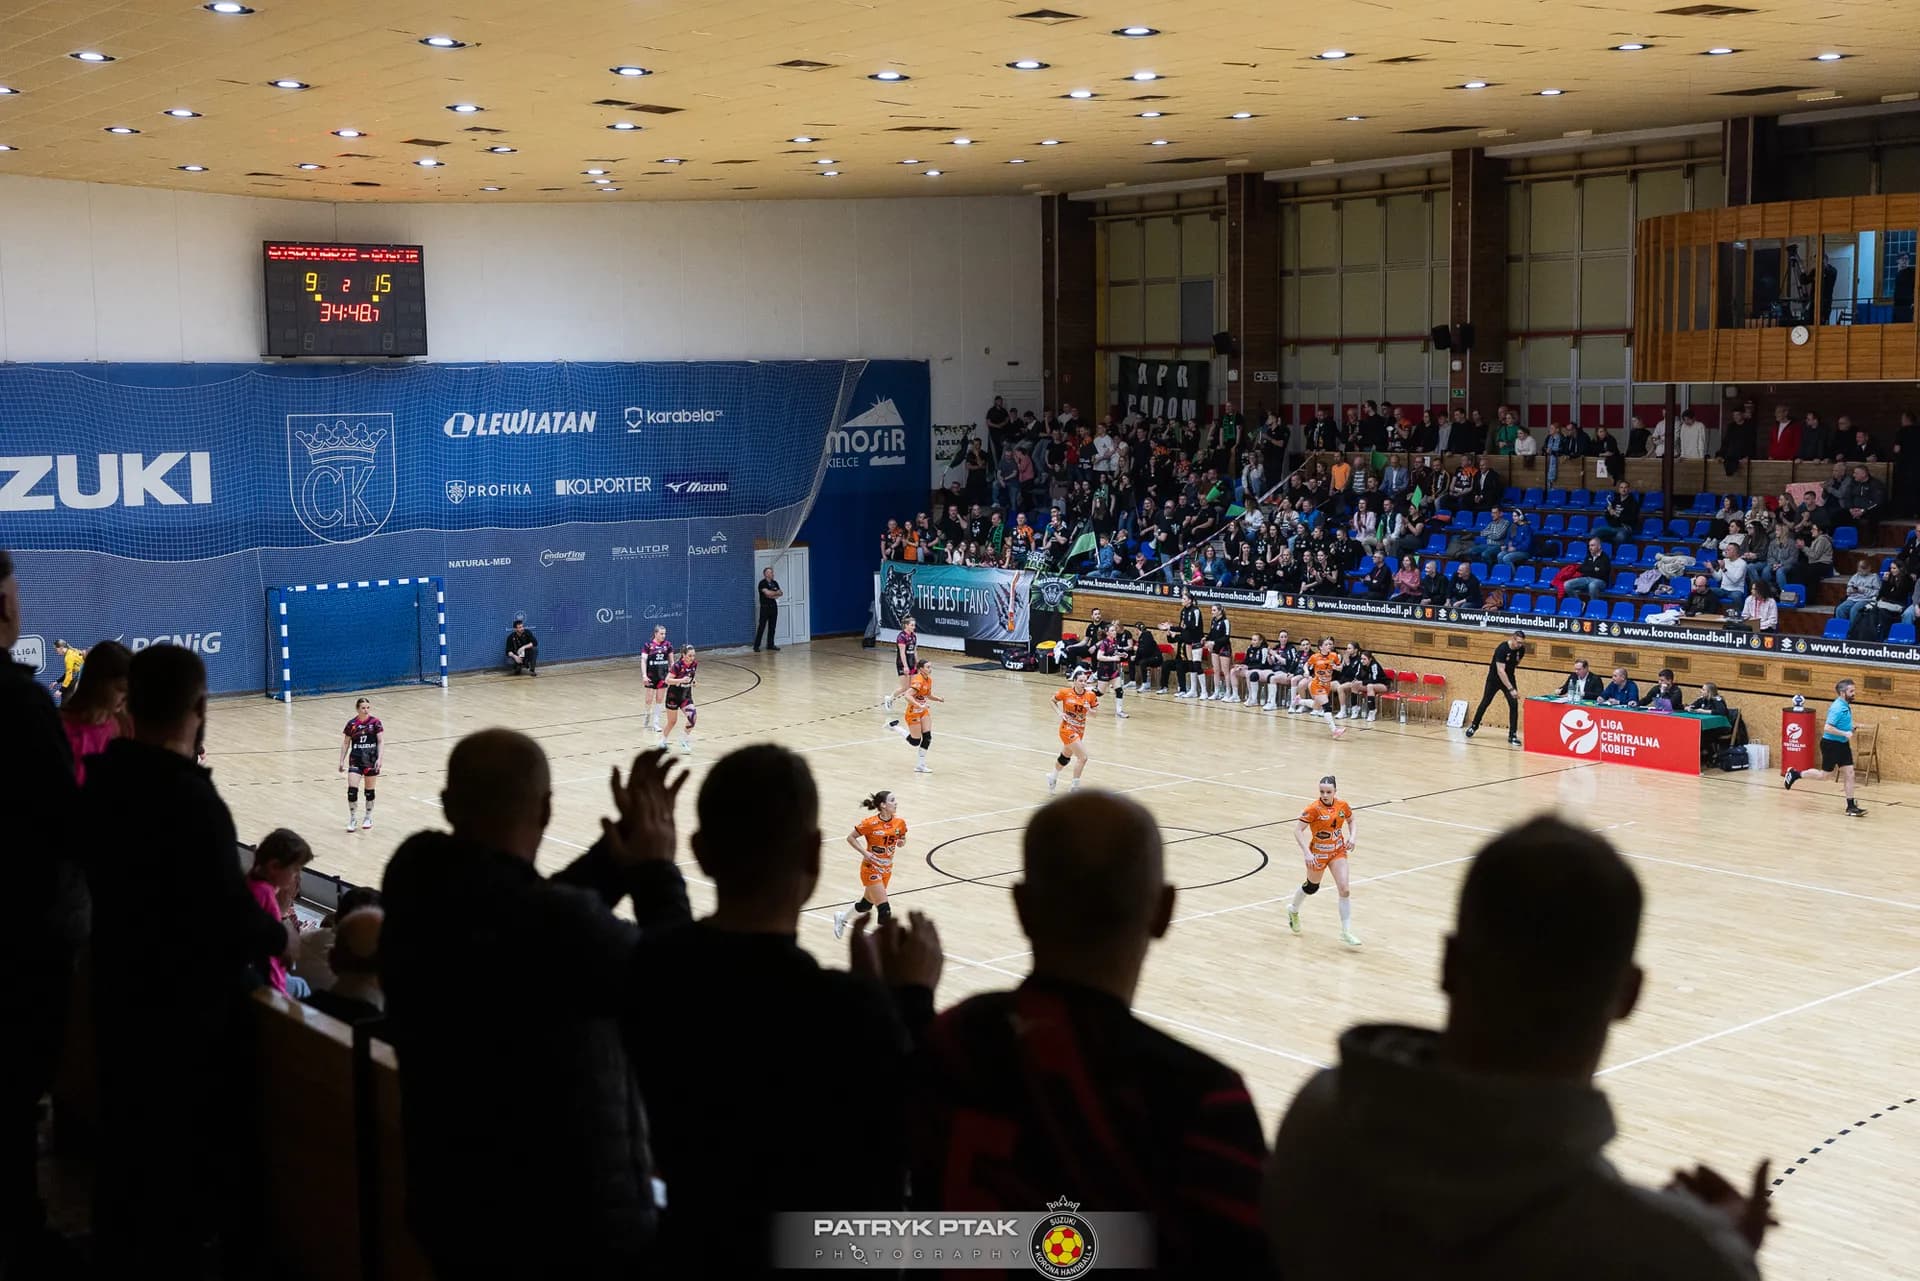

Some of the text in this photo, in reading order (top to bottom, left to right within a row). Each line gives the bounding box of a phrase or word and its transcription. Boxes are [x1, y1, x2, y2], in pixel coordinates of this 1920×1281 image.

[306, 273, 391, 292] 9 2 15
[1138, 363, 1188, 388] APR
[476, 408, 597, 436] LEWIATAN
[647, 409, 714, 424] karabela
[827, 457, 859, 468] KIELCE
[0, 451, 212, 511] ZUKI
[566, 476, 652, 495] KOLPORTER
[302, 465, 379, 528] CK
[468, 483, 532, 497] PROFIKA
[687, 543, 728, 555] Aswent
[448, 557, 512, 568] NATURAL-MED
[1078, 579, 1153, 594] www.koronahandball.pl
[917, 584, 990, 615] THE BEST FANS
[1317, 600, 1412, 616] www.koronahandball.pl
[1624, 627, 1746, 647] www.koronahandball.pl
[1810, 643, 1920, 660] www.koronahandb
[1601, 719, 1623, 731] LIGA
[360, 735, 368, 743] 17
[1601, 732, 1660, 748] CENTRALNA
[1601, 743, 1636, 757] KOBIET
[1330, 818, 1337, 828] 4
[883, 836, 896, 845] 15
